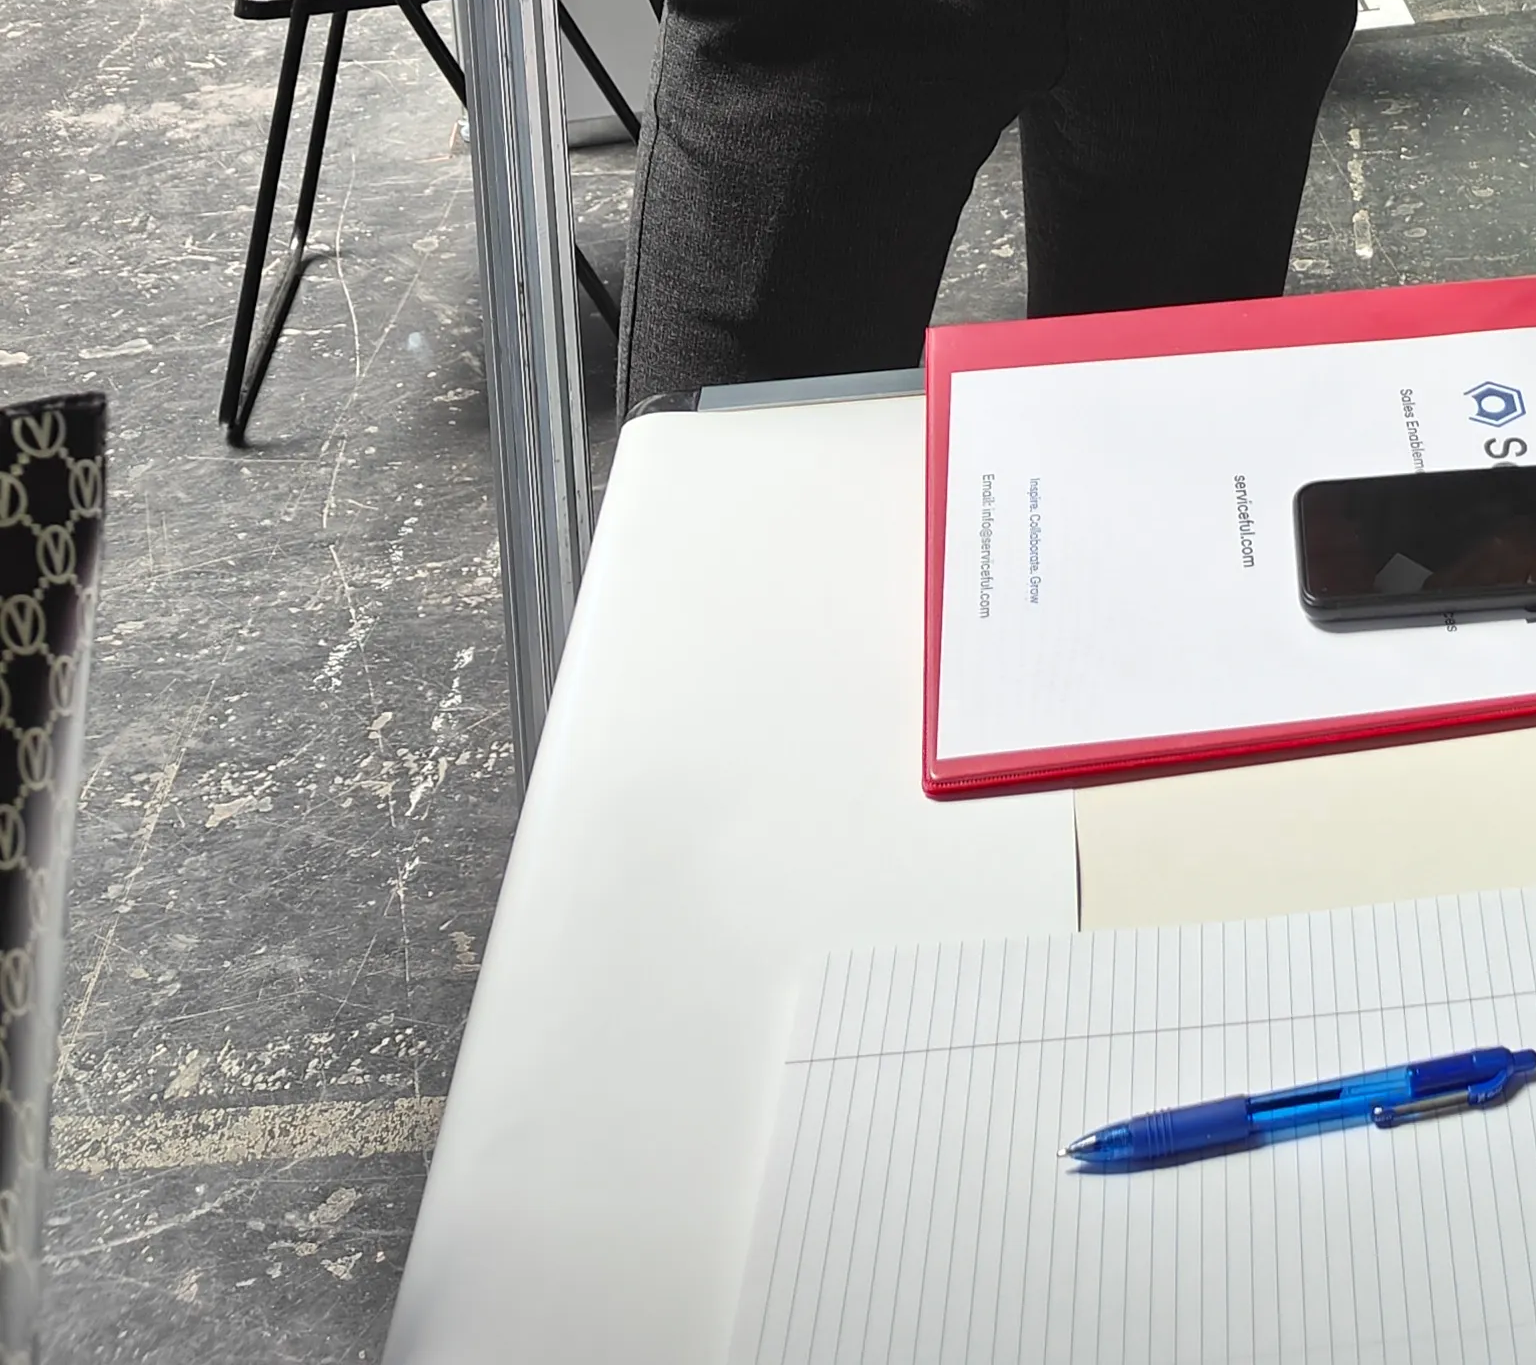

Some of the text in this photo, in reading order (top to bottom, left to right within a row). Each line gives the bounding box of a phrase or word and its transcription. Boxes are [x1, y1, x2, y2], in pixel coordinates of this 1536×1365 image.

[1400, 388, 1415, 419] Sales
[1028, 513, 1042, 575] Collaborate.
[1233, 474, 1257, 570] serviceful.com
[978, 508, 995, 620] info@serviceful.com
[1028, 575, 1042, 605] Grow
